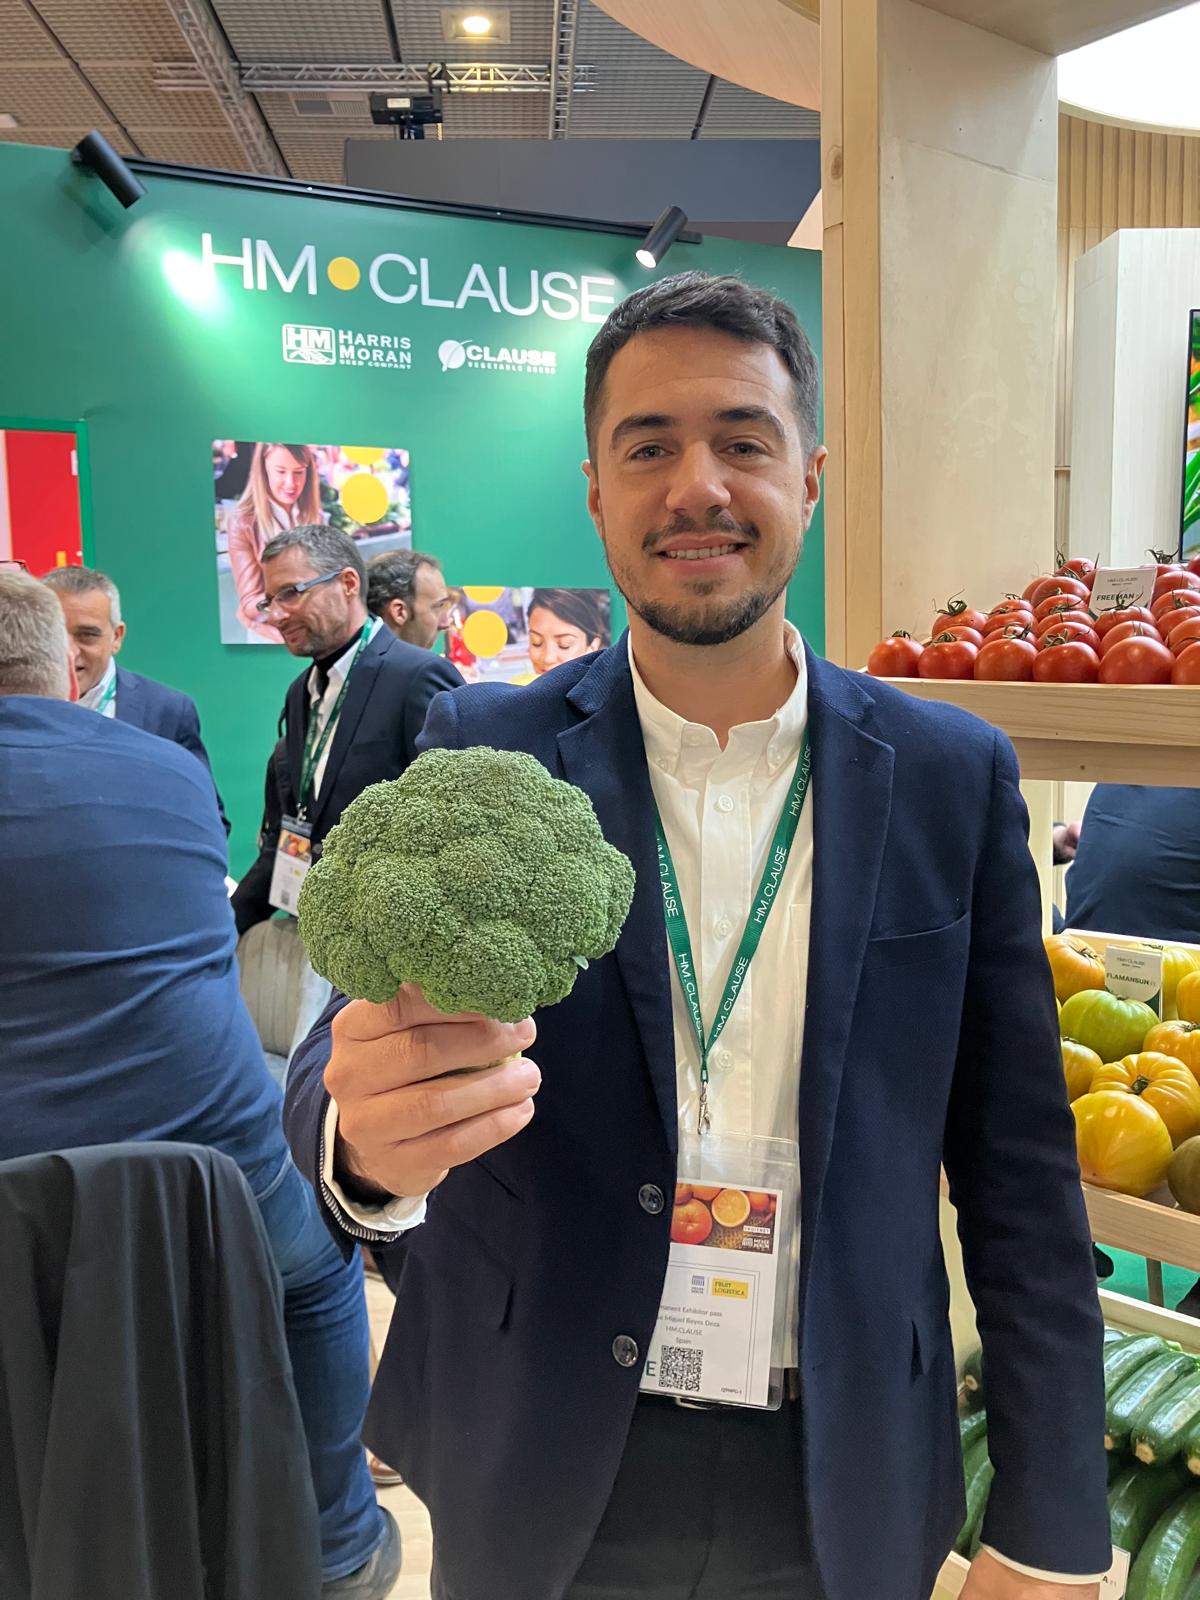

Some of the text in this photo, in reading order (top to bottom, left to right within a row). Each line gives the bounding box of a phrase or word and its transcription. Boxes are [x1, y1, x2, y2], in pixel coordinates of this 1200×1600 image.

[201, 233, 616, 324] HM CLAUSE
[338, 329, 412, 349] HARRIS
[338, 344, 412, 364] MORAN
[466, 345, 557, 368] CLAUSE
[1096, 592, 1135, 601] FREEMAN
[1106, 972, 1149, 985] FLAMANSUN
[714, 1287, 745, 1296] LOGISTICA
